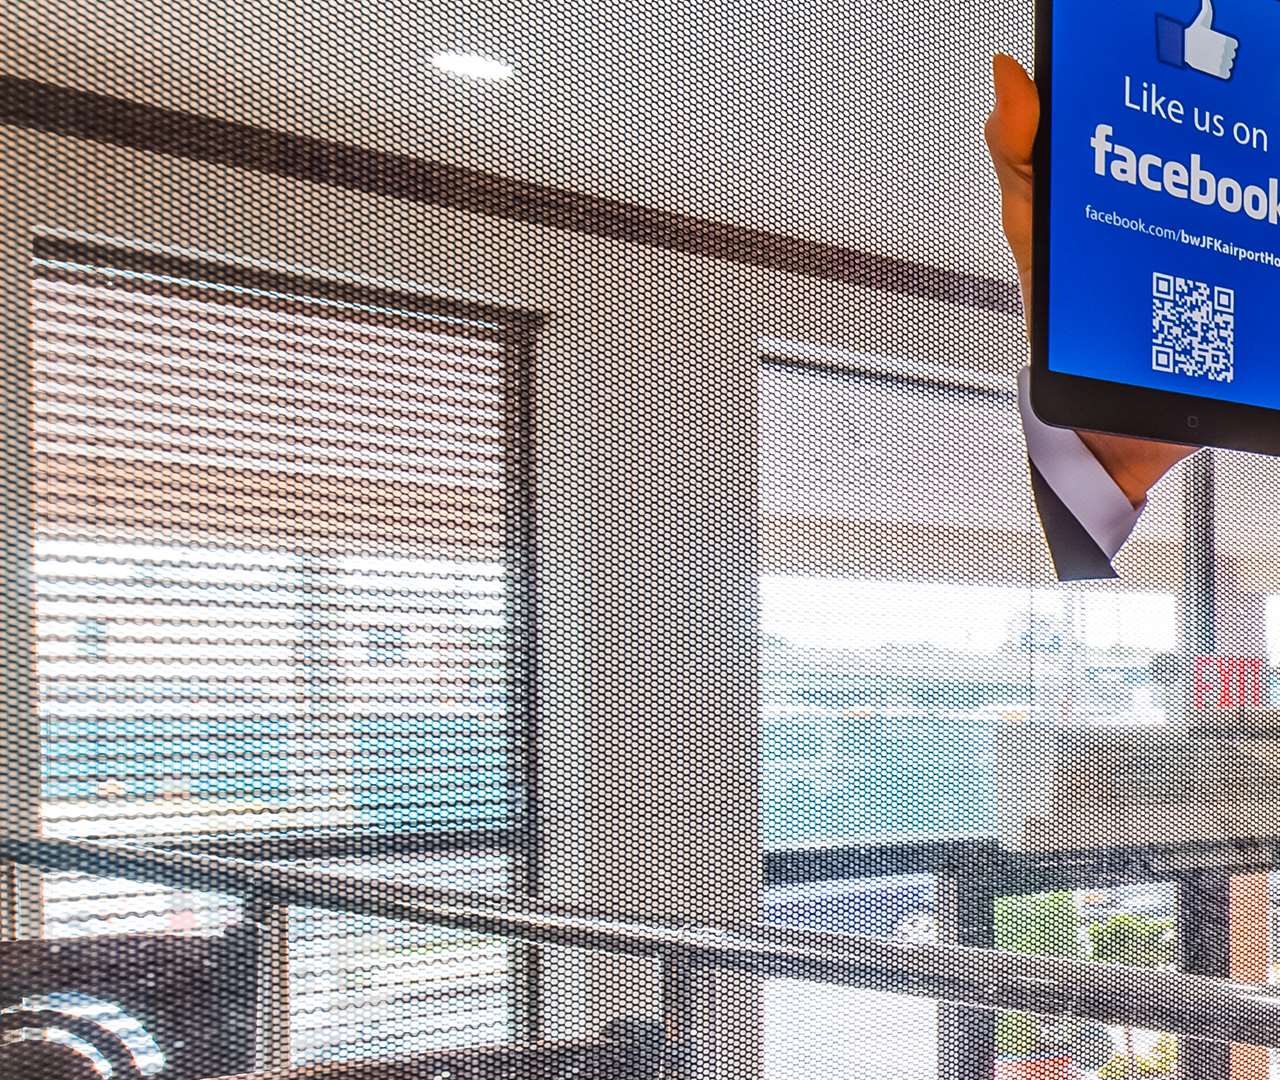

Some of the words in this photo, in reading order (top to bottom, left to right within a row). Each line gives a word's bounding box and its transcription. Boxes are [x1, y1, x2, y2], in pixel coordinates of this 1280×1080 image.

[1124, 75, 1184, 124] Like
[1194, 107, 1225, 137] us
[1233, 122, 1268, 152] on
